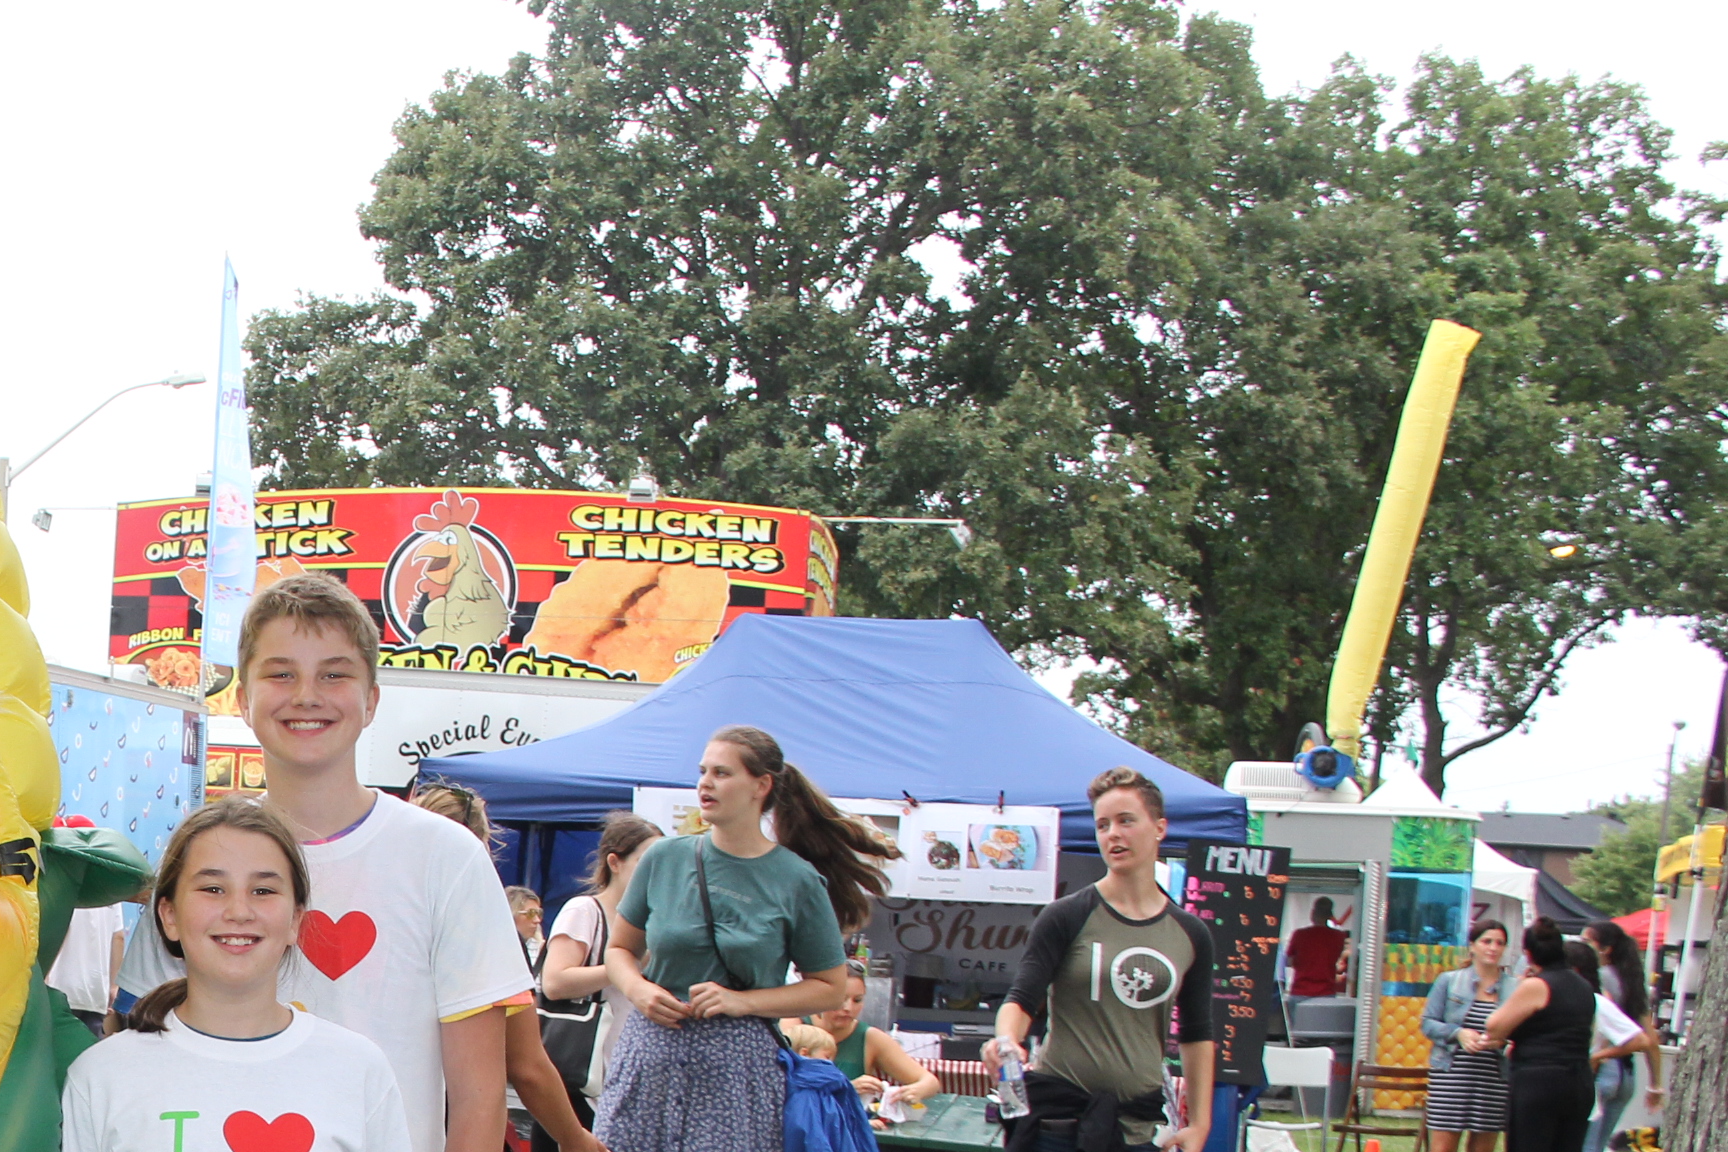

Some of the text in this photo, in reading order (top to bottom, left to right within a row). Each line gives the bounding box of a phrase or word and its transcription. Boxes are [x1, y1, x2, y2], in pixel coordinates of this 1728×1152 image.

[159, 499, 334, 537] CHKEN
[570, 504, 779, 544] CHICKEN
[145, 540, 184, 563] ON
[256, 529, 354, 558] TICK
[557, 532, 785, 573] TENDERS
[128, 626, 184, 649] RIBBON
[398, 714, 541, 767] Special Ev
[1205, 845, 1272, 877] MENU
[959, 958, 1007, 972] CAFE
